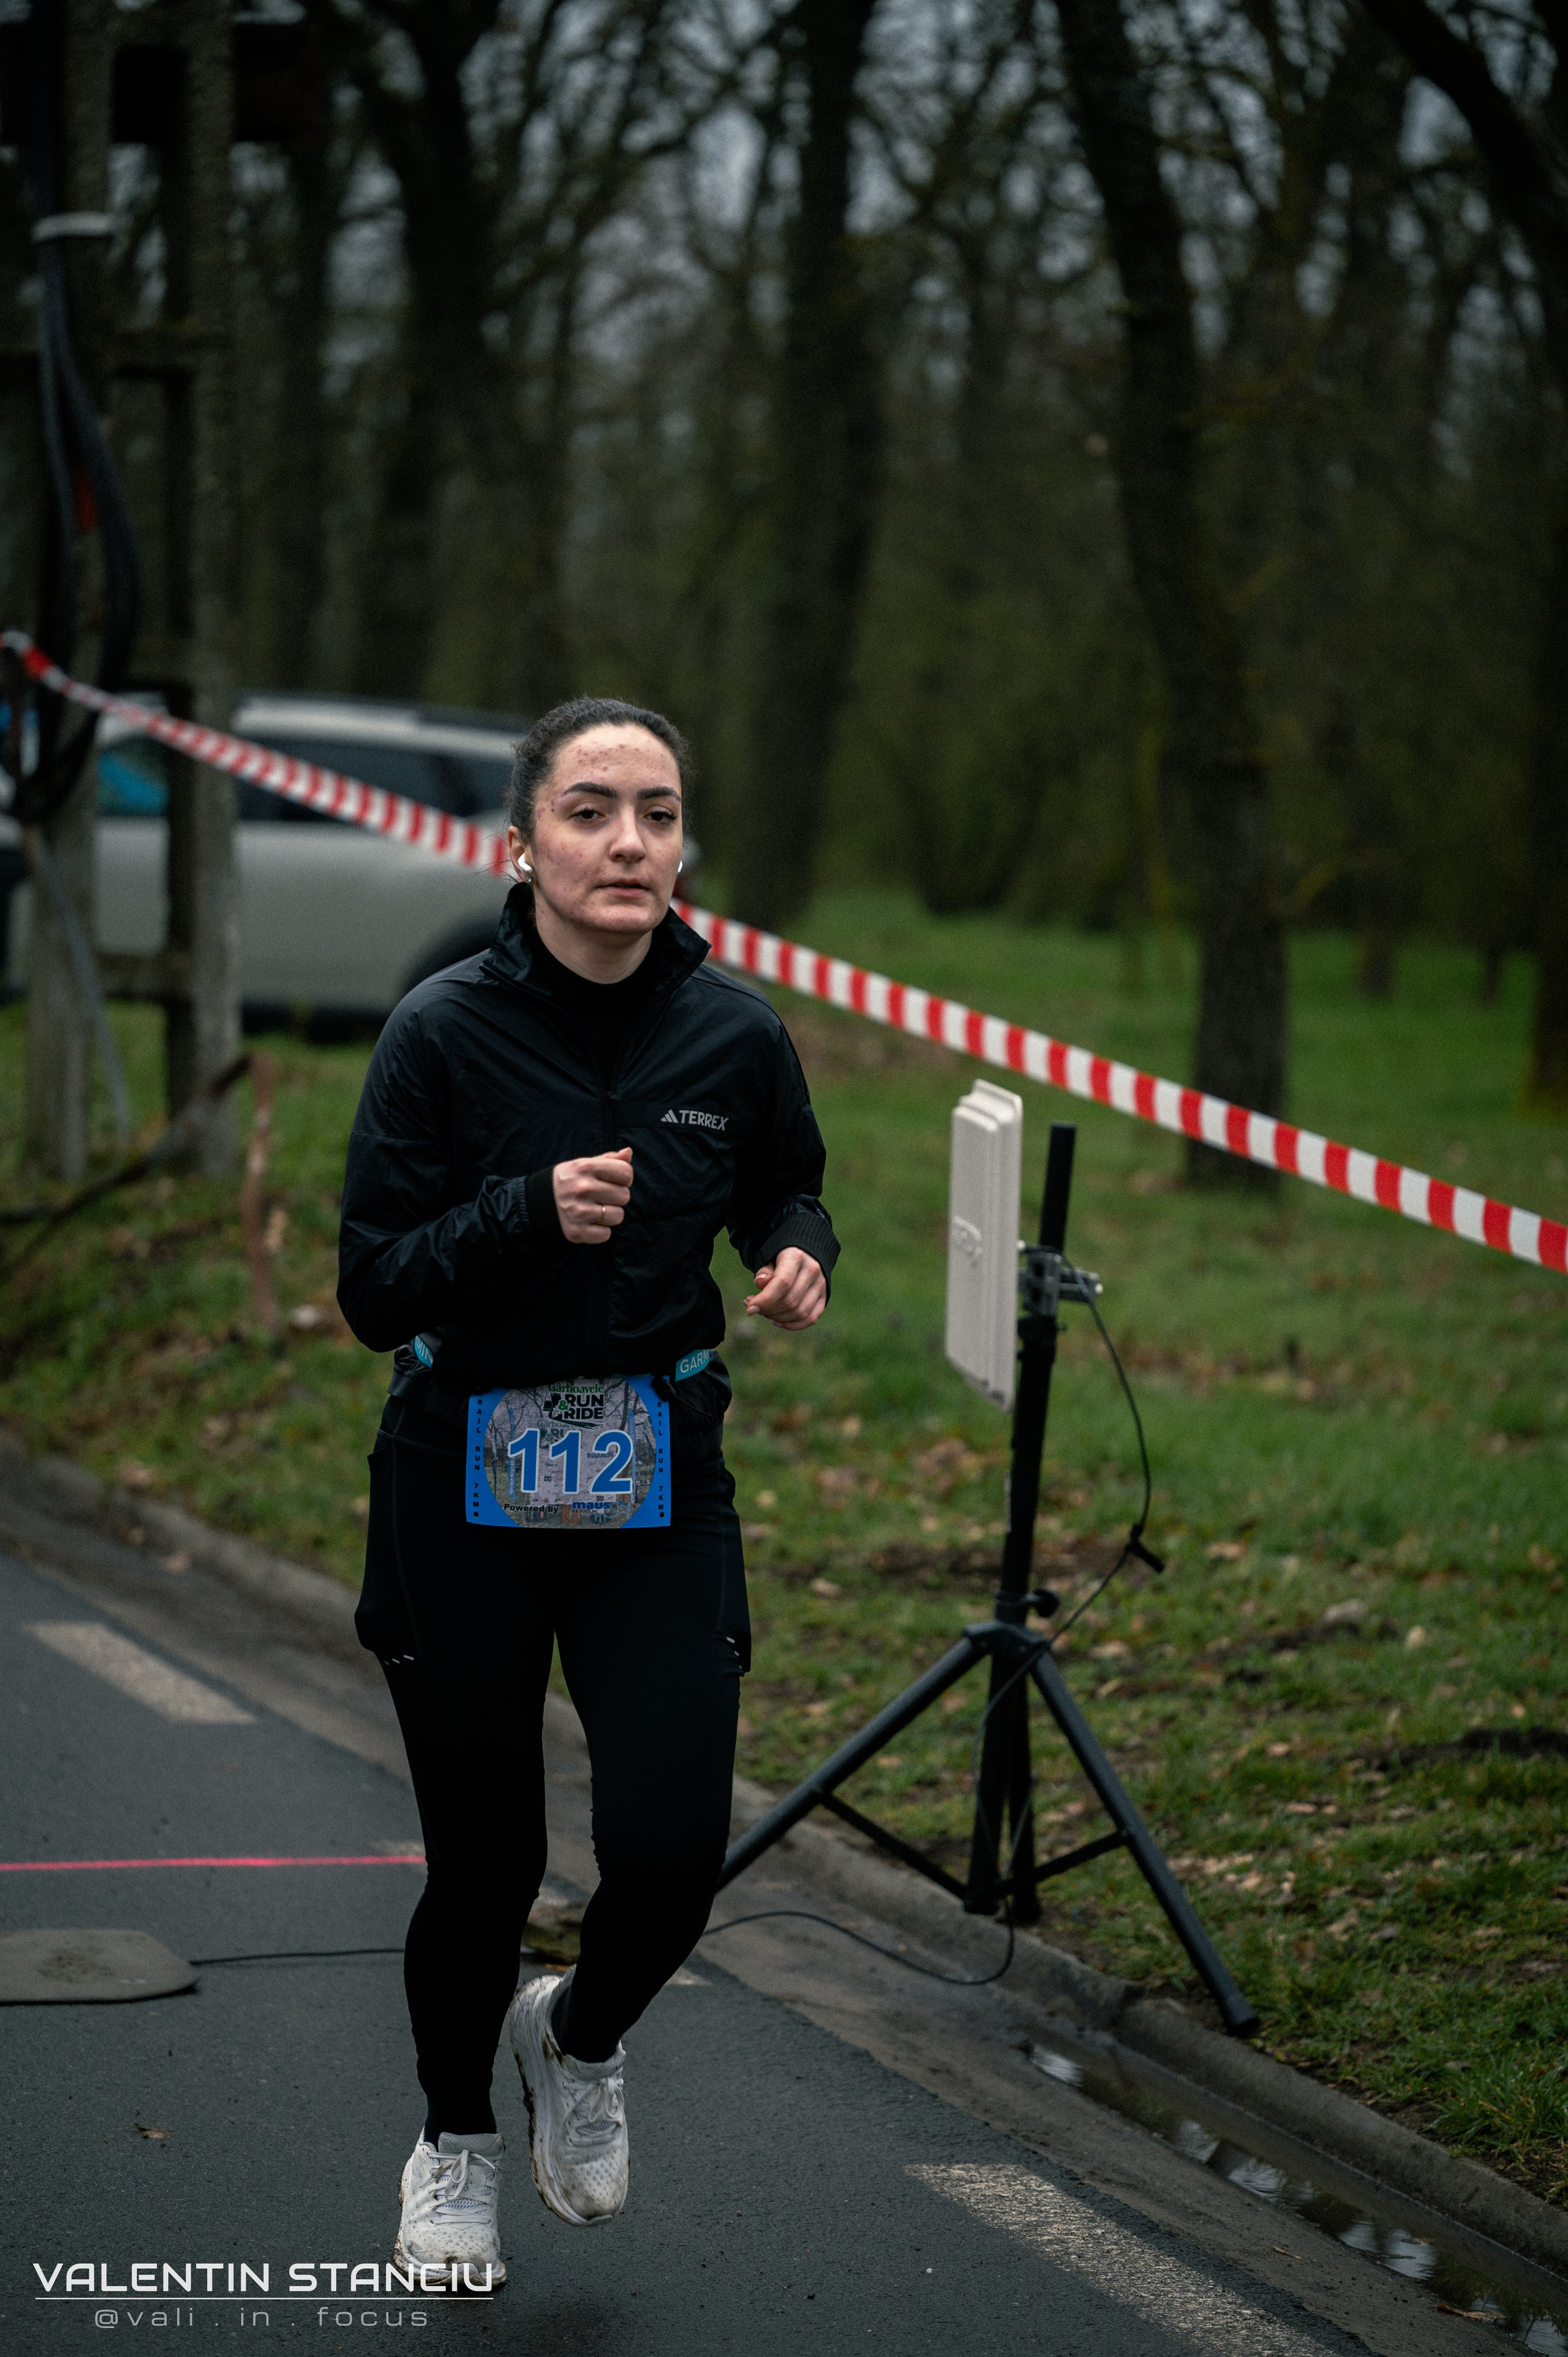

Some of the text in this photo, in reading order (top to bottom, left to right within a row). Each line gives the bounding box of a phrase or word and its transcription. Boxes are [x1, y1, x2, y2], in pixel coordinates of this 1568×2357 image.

[679, 1109, 729, 1131] TERREX
[680, 1349, 709, 1373] GARM
[548, 1382, 604, 1393] Gârboavele
[558, 1400, 569, 1411] &
[565, 1394, 604, 1407] RUN
[564, 1408, 603, 1419] RIDE
[508, 1428, 633, 1494] 112
[503, 1503, 559, 1514] Powered by
